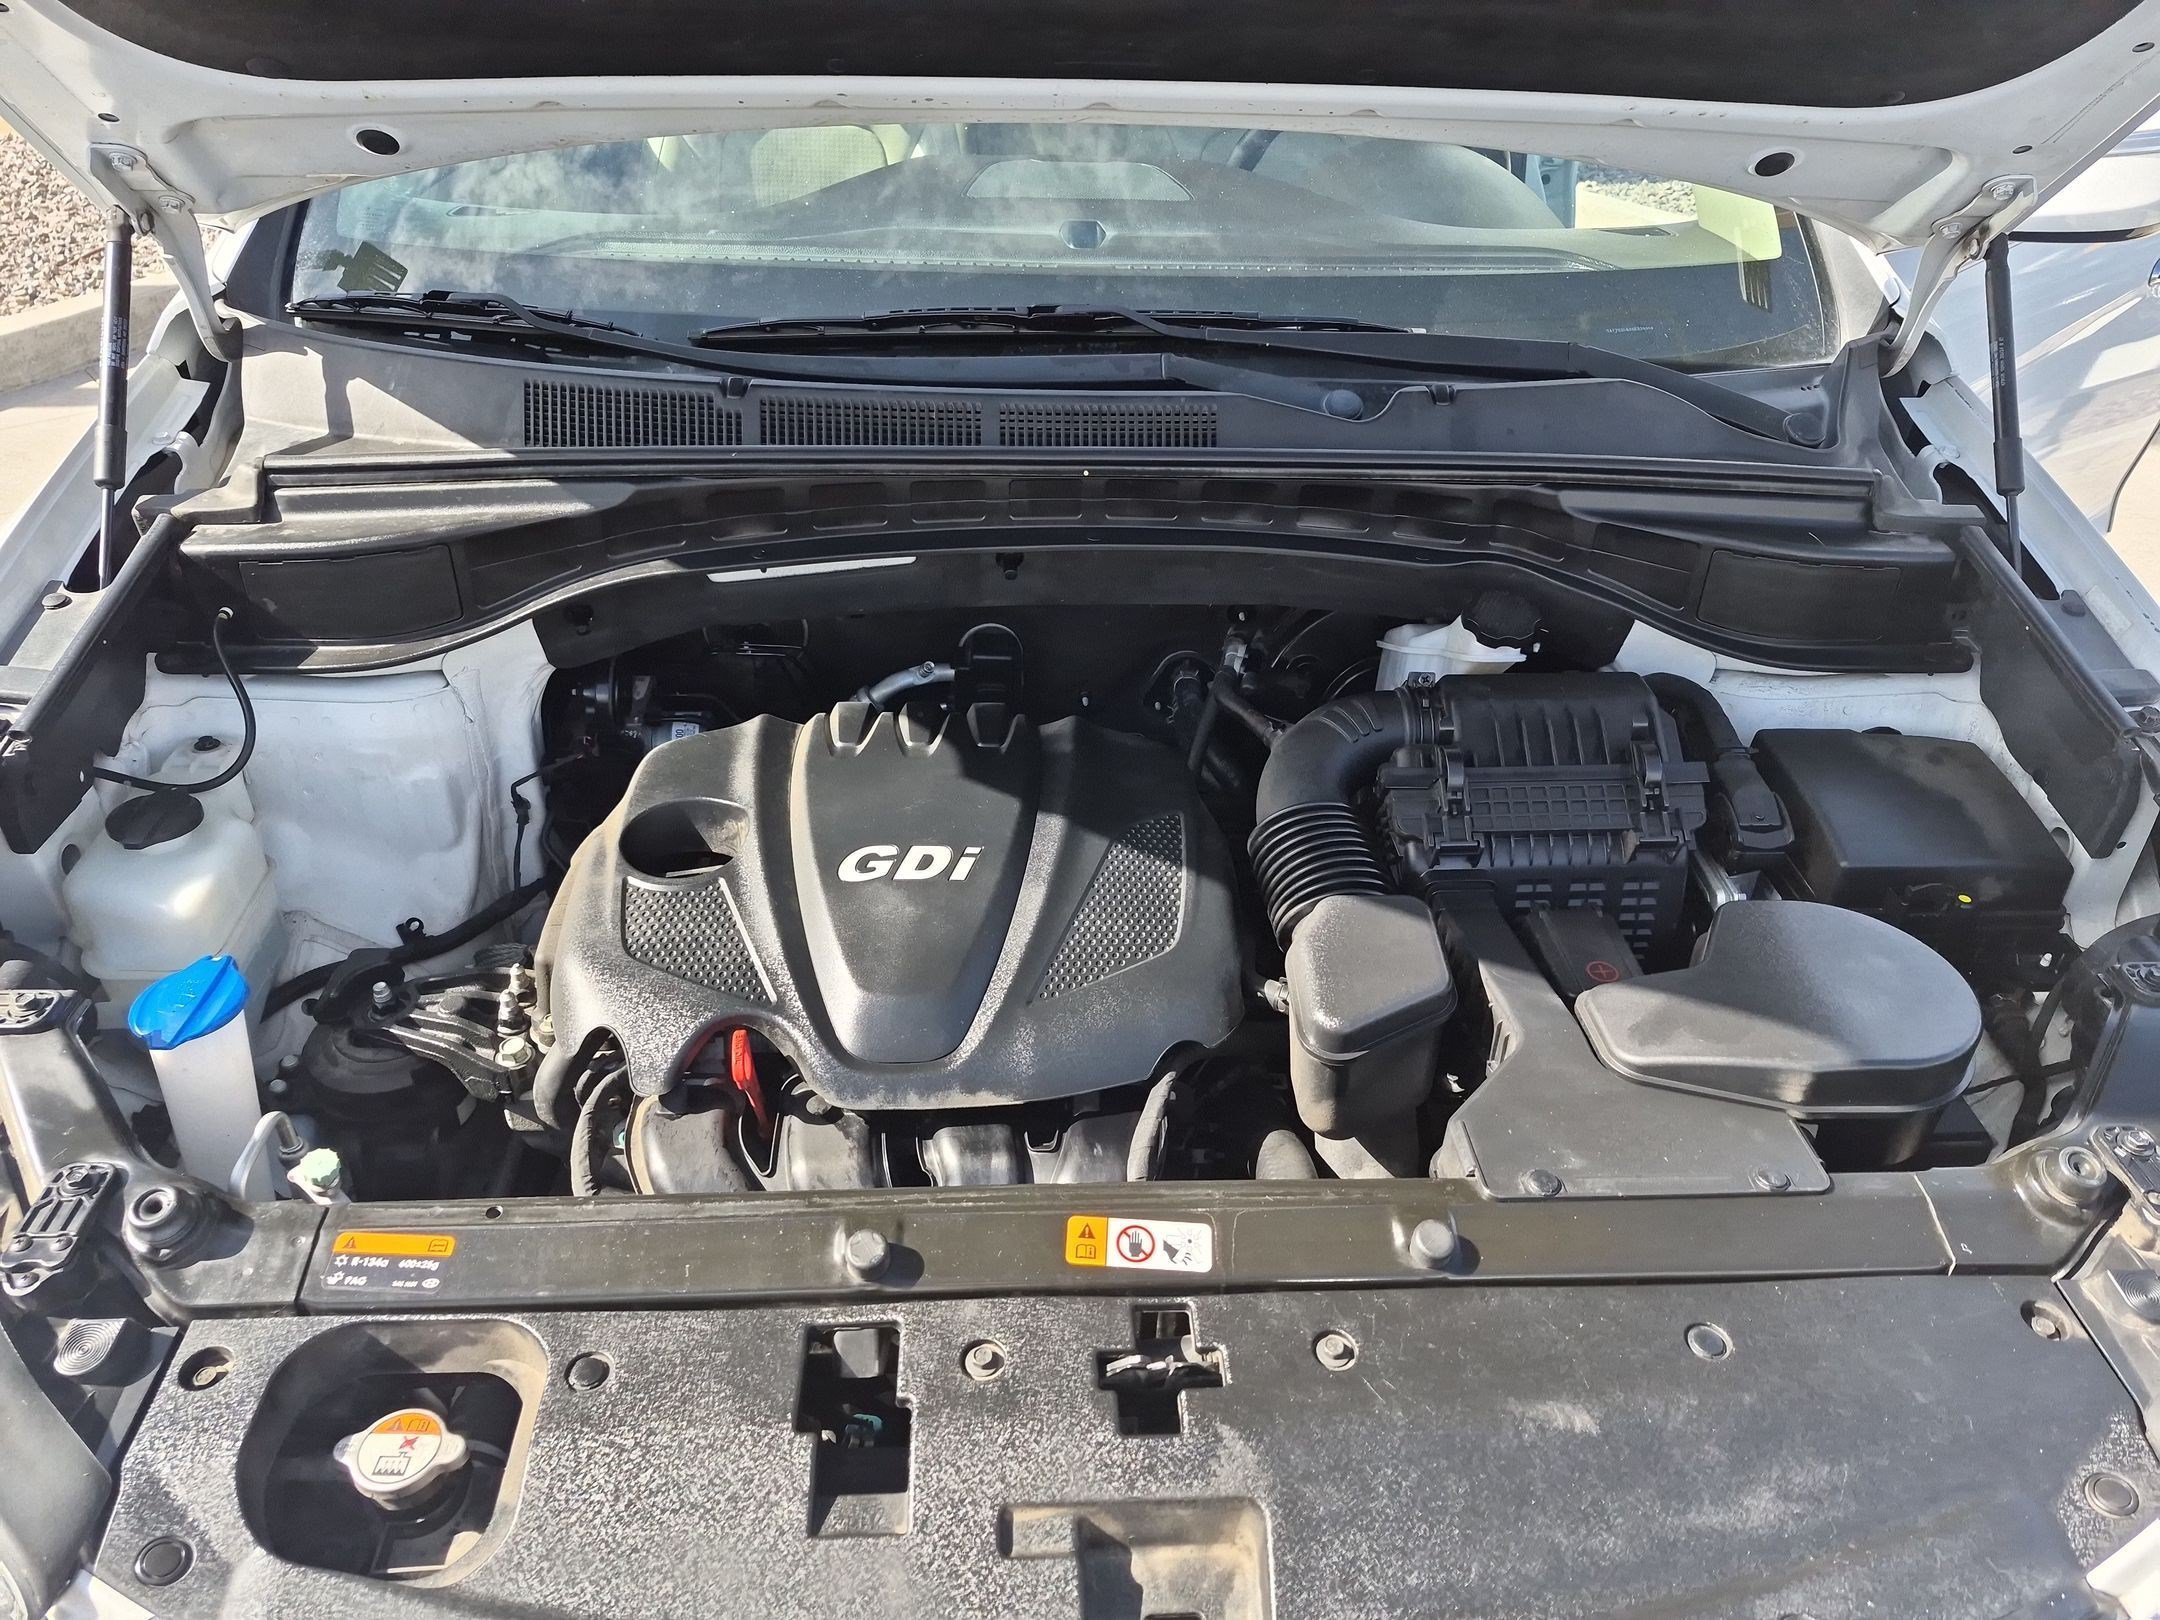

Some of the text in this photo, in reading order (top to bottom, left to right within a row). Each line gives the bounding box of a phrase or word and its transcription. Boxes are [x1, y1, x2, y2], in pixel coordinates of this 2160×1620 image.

[837, 844, 984, 882] GDi
[350, 1257, 389, 1268] R-134a
[344, 1276, 368, 1286] PAG
